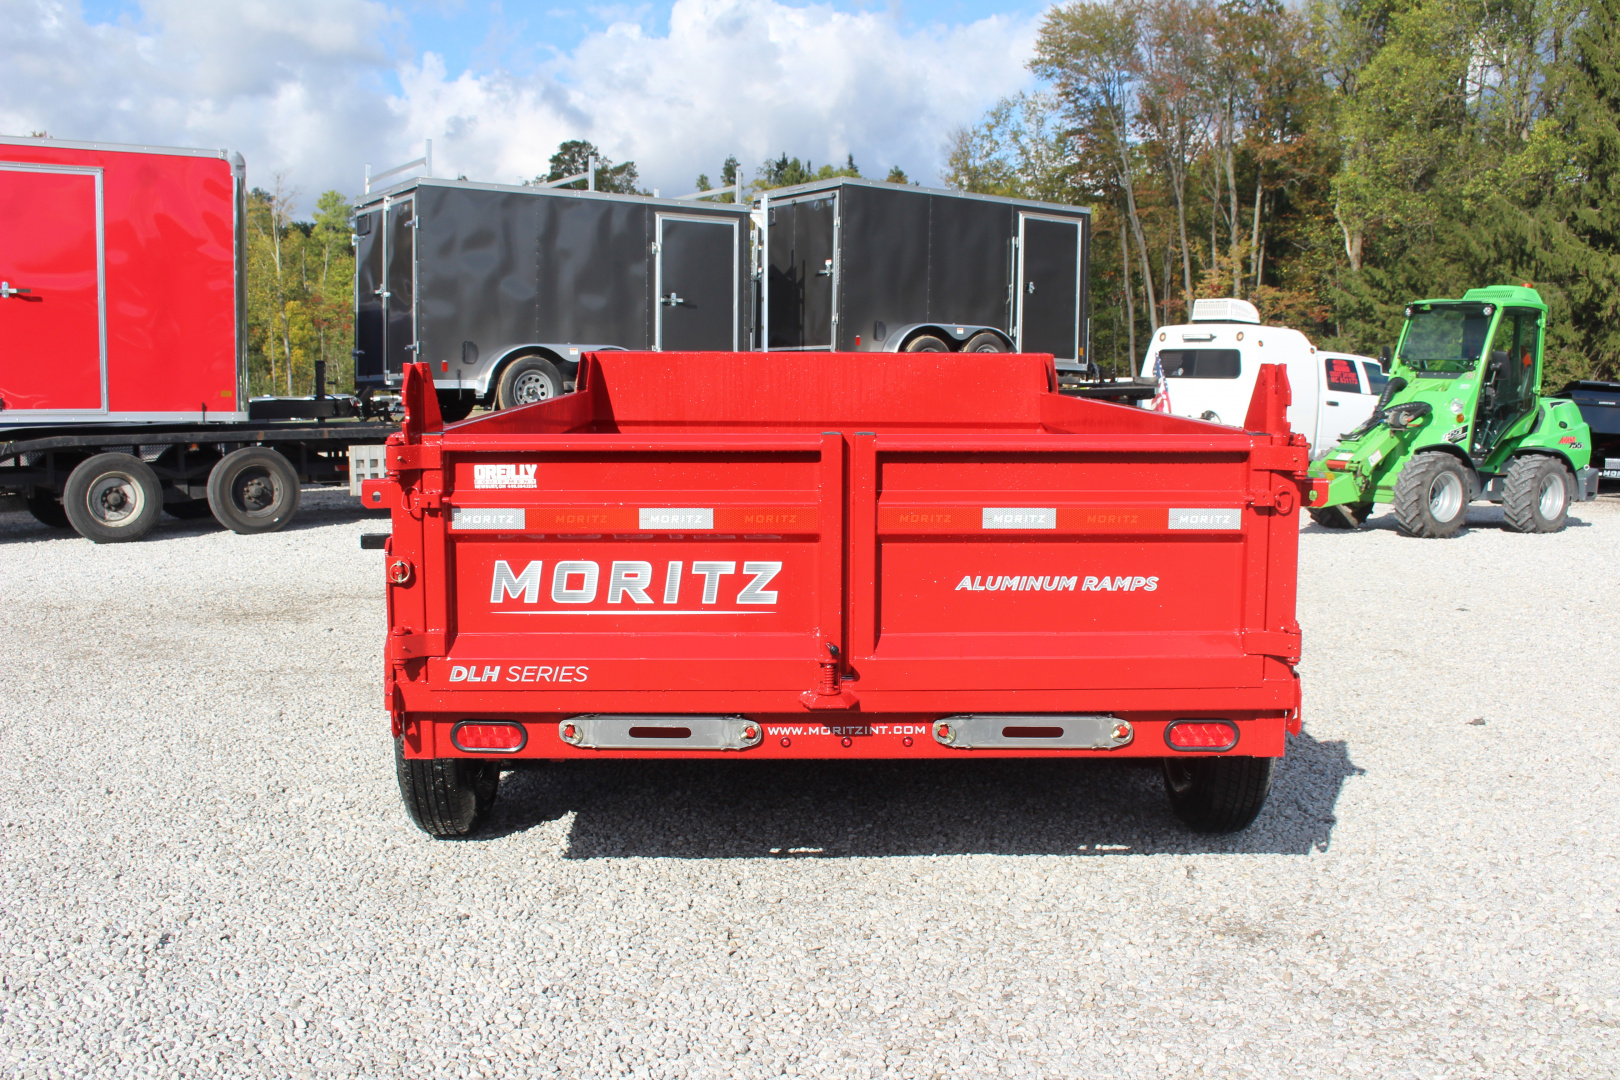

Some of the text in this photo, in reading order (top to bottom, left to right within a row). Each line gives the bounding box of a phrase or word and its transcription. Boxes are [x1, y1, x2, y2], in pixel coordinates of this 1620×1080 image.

[462, 515, 797, 523] MORITZ MORITZ MORITZ MORITZ
[899, 514, 1231, 523] MORITZ MORITZ MORITZ MORITZ
[490, 560, 783, 604] MORITZ
[955, 575, 1160, 591] ALUMINUM RAMPS
[449, 665, 589, 682] DLH SERIES
[767, 726, 926, 735] WWW.MORITZINT.COM
